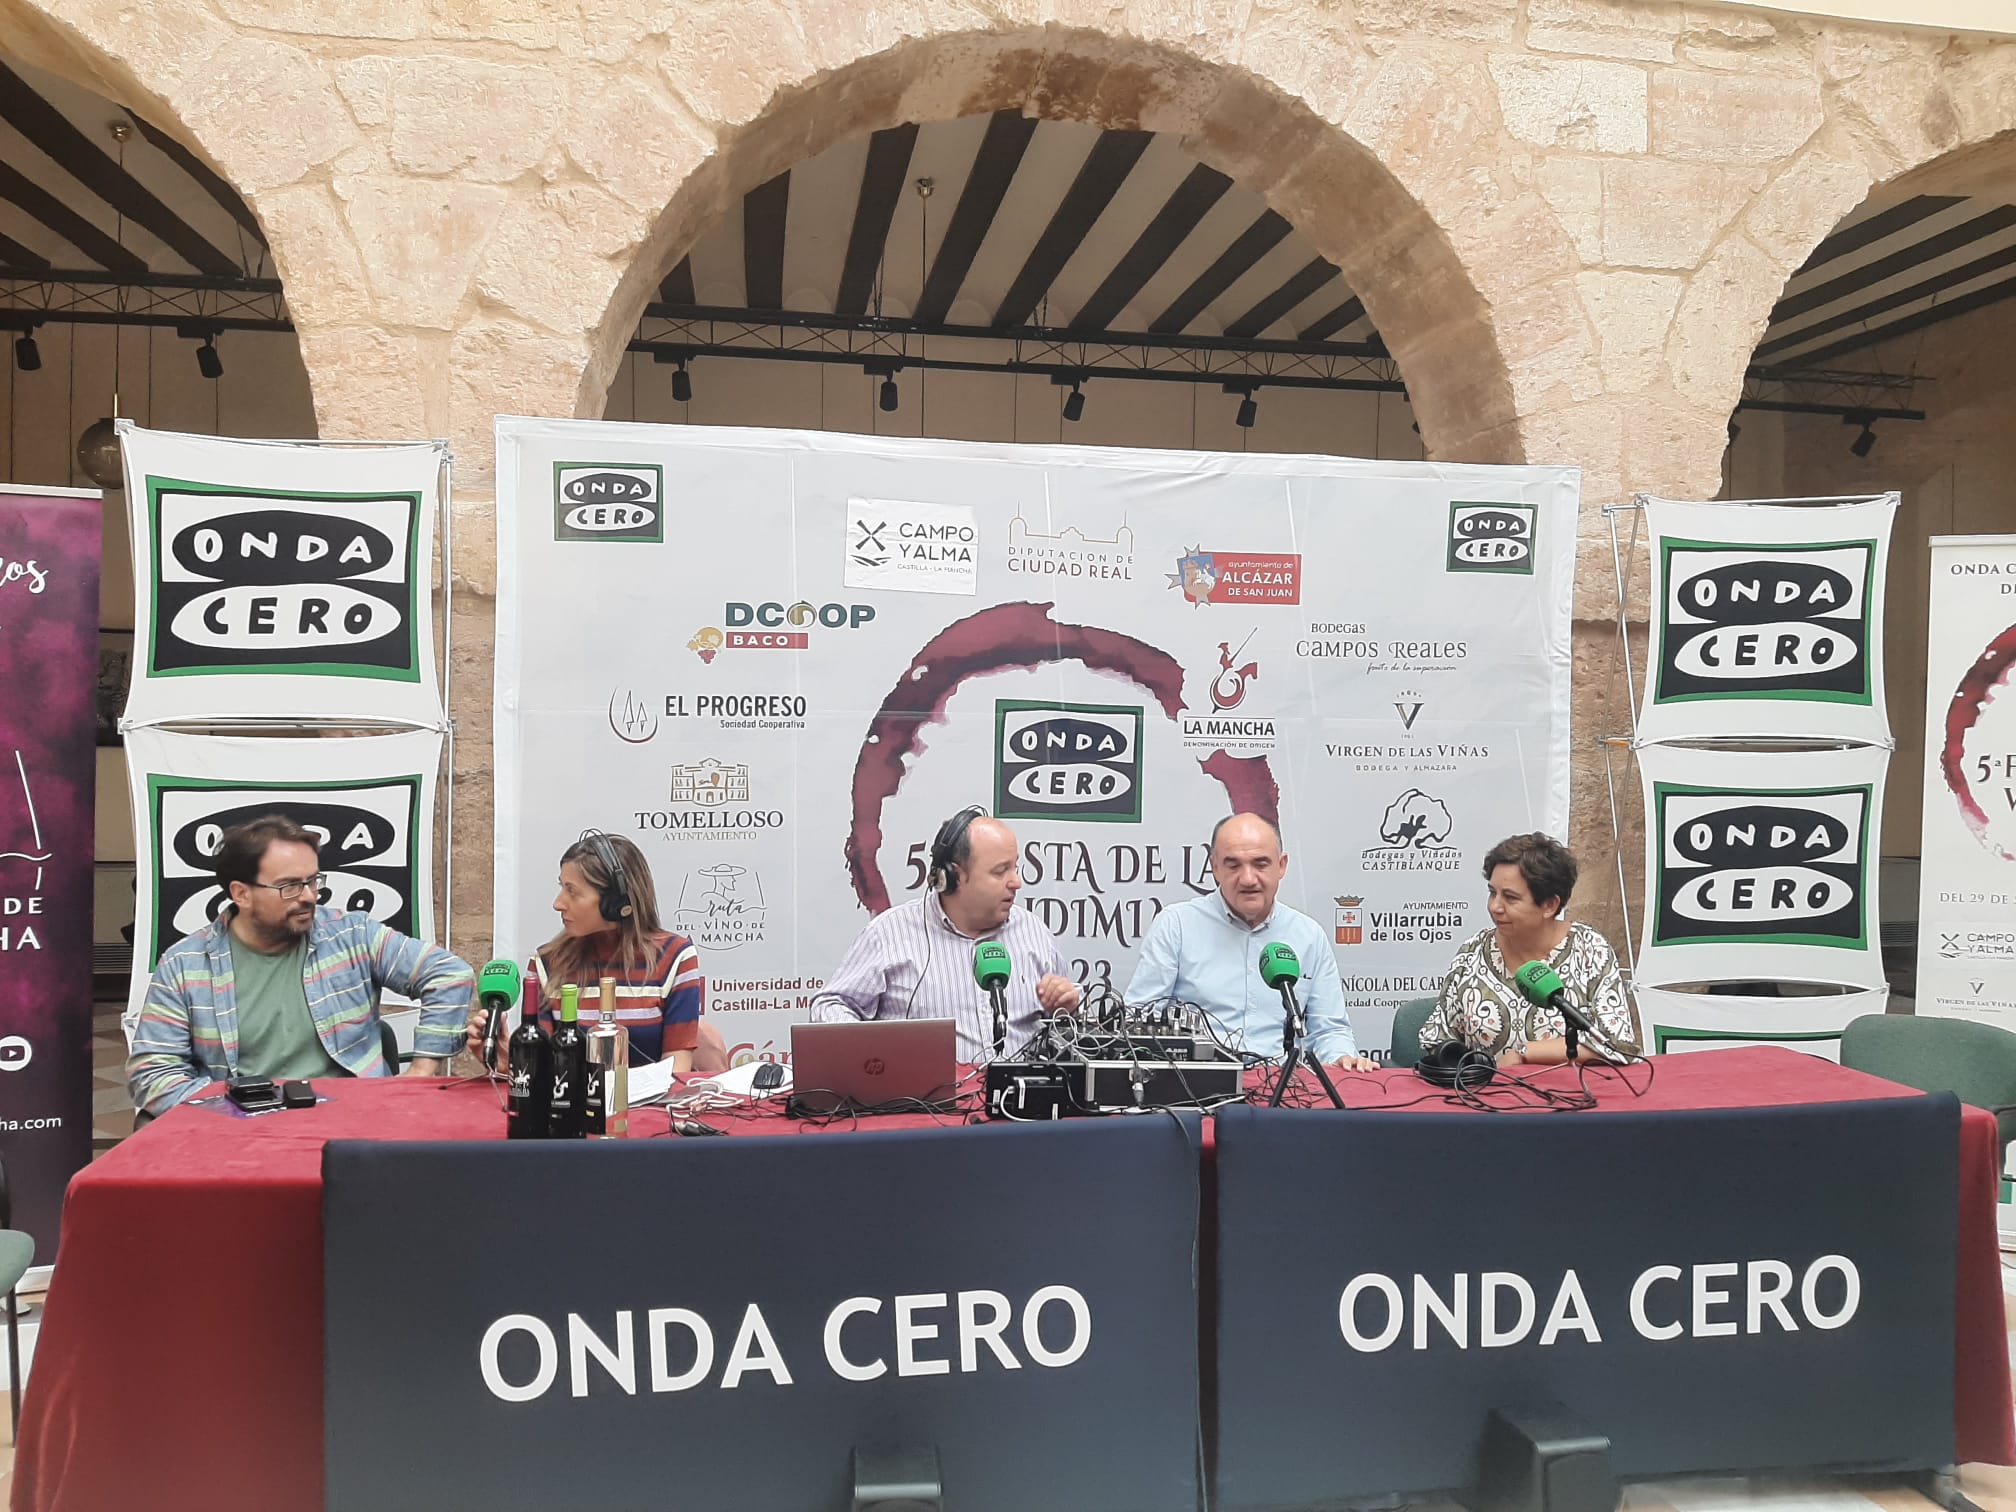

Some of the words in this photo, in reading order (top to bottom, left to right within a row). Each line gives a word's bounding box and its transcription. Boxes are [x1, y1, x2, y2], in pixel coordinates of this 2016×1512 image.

[573, 481, 643, 496] ONDA
[577, 508, 644, 525] CERO
[899, 522, 974, 542] CAMPO
[1464, 519, 1520, 532] ONDA
[193, 528, 373, 563] ONDA
[899, 543, 972, 563] YALMA
[1465, 543, 1519, 557] CERO
[1116, 555, 1134, 564] DE
[1228, 561, 1282, 569] ayuntamiento
[1007, 558, 1082, 576] CIUDAD
[1089, 564, 1132, 580] REAL
[1222, 568, 1293, 585] ALCÁZAR
[1950, 563, 2001, 576] ONDA
[1228, 587, 1241, 596] DE
[1243, 588, 1264, 596] SAN
[1266, 588, 1293, 597] JUAN
[1695, 578, 1836, 607] ONDA
[203, 597, 373, 634] CERO
[733, 635, 789, 646] BACO
[1699, 633, 1835, 668] CERO
[665, 695, 689, 717] EL
[696, 695, 807, 717] PROGRESO
[719, 719, 757, 729] Sociedad
[758, 719, 806, 730] Cooperativa
[1183, 720, 1203, 735] LA
[1206, 721, 1275, 736] MANCHA
[1021, 730, 1116, 752] ONDA
[1326, 744, 1384, 758] VIRGEN
[1388, 747, 1406, 758] DE
[1410, 747, 1433, 758] LAS
[1437, 743, 1489, 758] VIÑAS
[1355, 764, 1398, 772] BODEGA
[1413, 764, 1457, 772] ALMAZARA
[1026, 770, 1116, 795] CERO
[634, 810, 784, 830] TOMELLOSO
[662, 831, 757, 841] AYUNTAMIENTO
[1690, 823, 1832, 851] ONDA
[1361, 850, 1404, 862] Bodegas
[905, 841, 927, 889] 5
[1021, 841, 1105, 893] STA
[1107, 845, 1167, 883] DE
[1362, 860, 1460, 871] CASTIBLANQUE
[1697, 878, 1831, 910] CERO
[1940, 892, 1966, 903] DEL
[1970, 893, 1985, 903] 29
[1990, 894, 2008, 905] DE
[4, 897, 43, 914] DE
[1402, 902, 1469, 910] AYUNTAMIENTO
[1024, 895, 1163, 948] DIMI
[1369, 911, 1463, 928] Villarrubia
[701, 932, 765, 942] MANCHA
[1370, 928, 1388, 941] de
[1393, 928, 1414, 941] los
[1419, 928, 1453, 944] Ojos
[1967, 933, 2016, 943] CAMPO
[1967, 944, 2015, 954] YALMA
[712, 978, 802, 992] Universidad
[806, 977, 825, 989] de
[1071, 959, 1112, 998] 23
[1341, 975, 1390, 992] NÍCOLA
[1393, 976, 1417, 991] DEL
[1419, 976, 1445, 991] CAR
[712, 996, 792, 1012] Castilla-La
[1345, 998, 1372, 1008] iedad
[1338, 1269, 1602, 1353] ONDA
[1629, 1254, 1861, 1341] CERO
[479, 1303, 793, 1403] ONDA
[823, 1285, 1094, 1382] CERO
